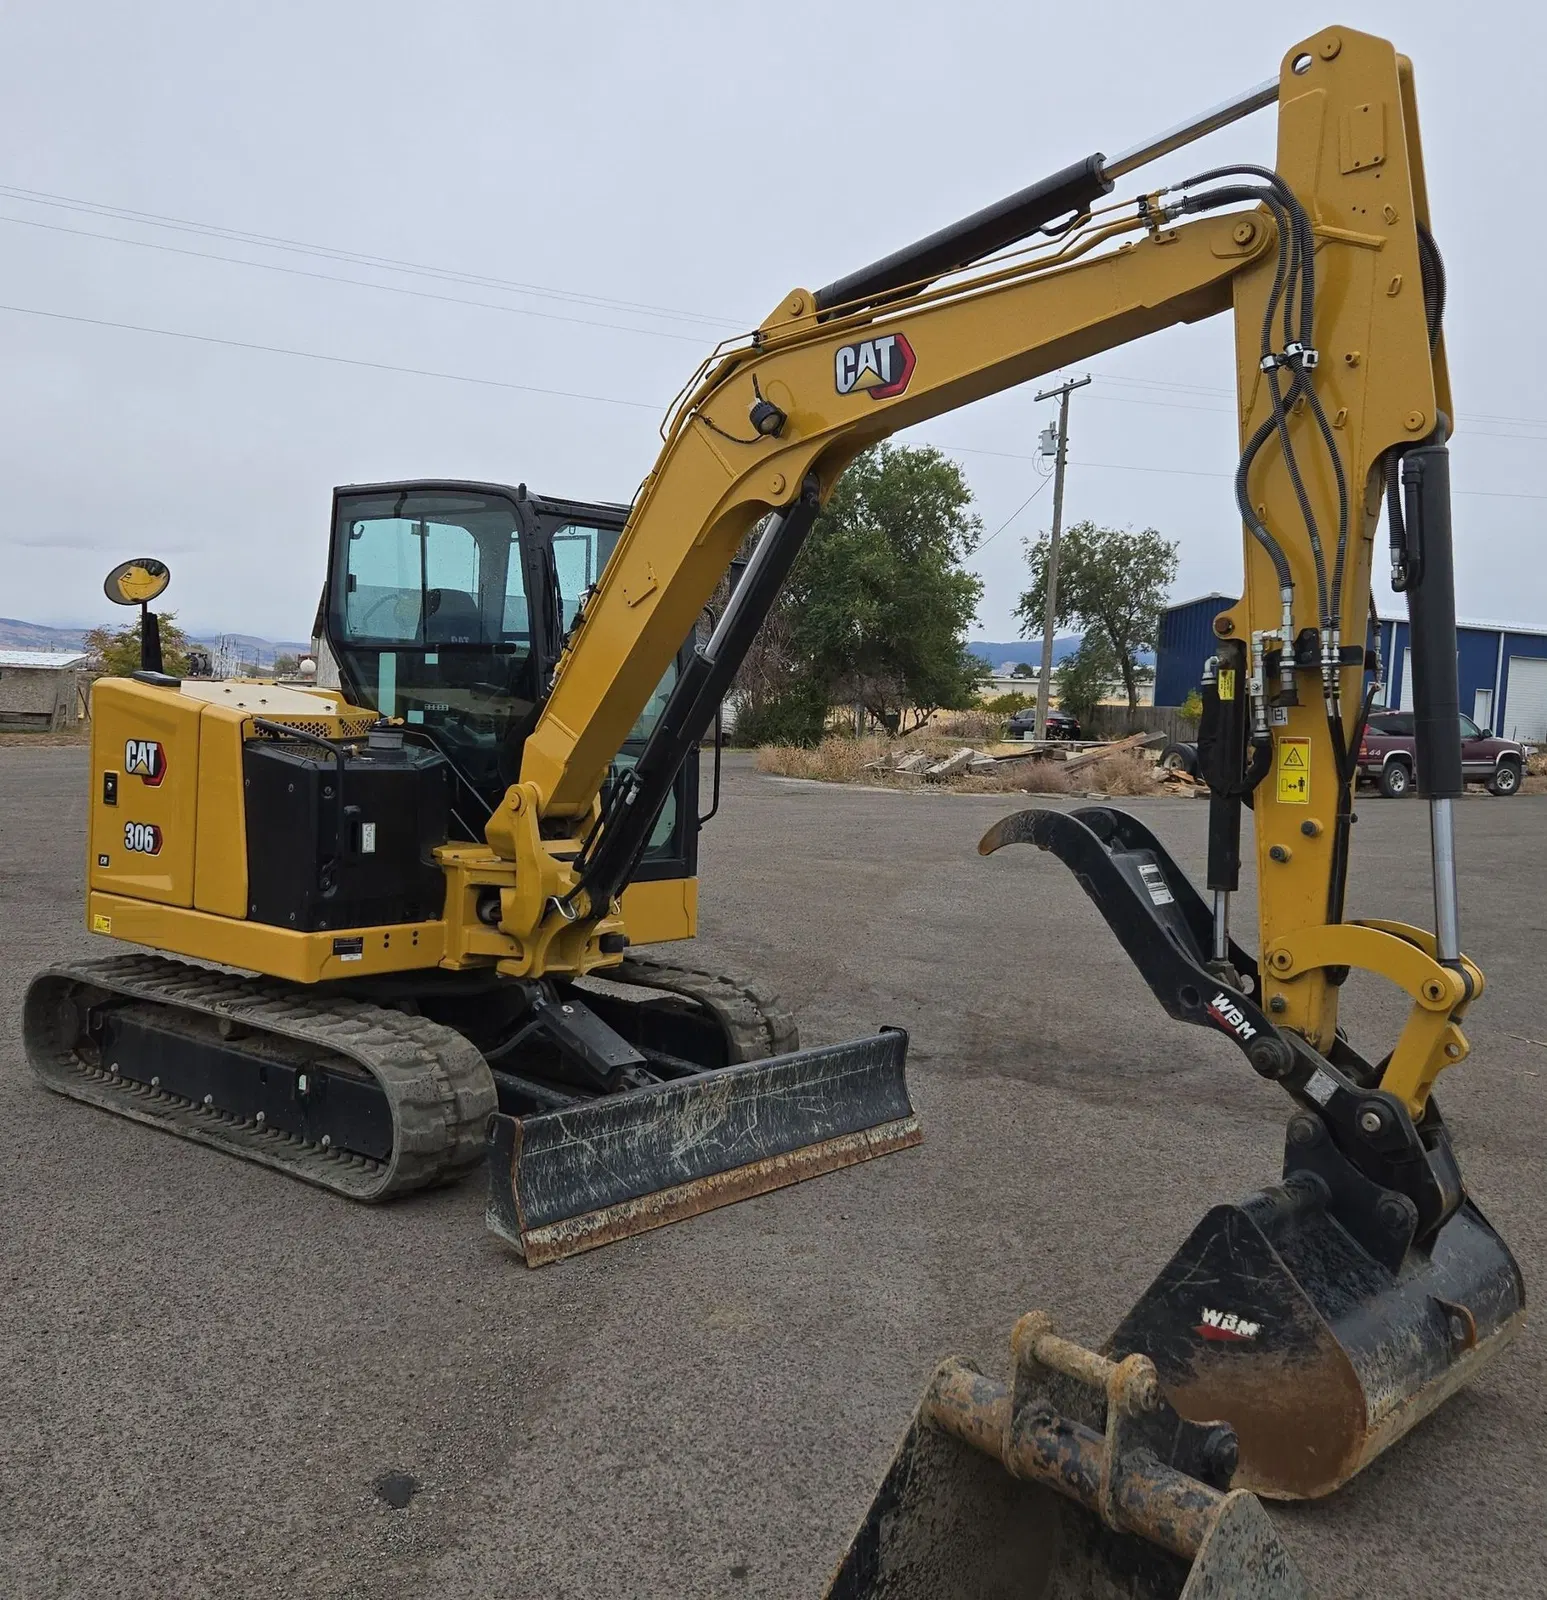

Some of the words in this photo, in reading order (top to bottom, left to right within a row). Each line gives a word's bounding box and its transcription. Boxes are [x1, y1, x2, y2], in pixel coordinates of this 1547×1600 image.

[836, 335, 895, 394] CAT
[126, 740, 158, 776] CAT
[125, 822, 154, 852] 306
[1211, 992, 1257, 1040] WBM
[1202, 1307, 1260, 1336] WBM
